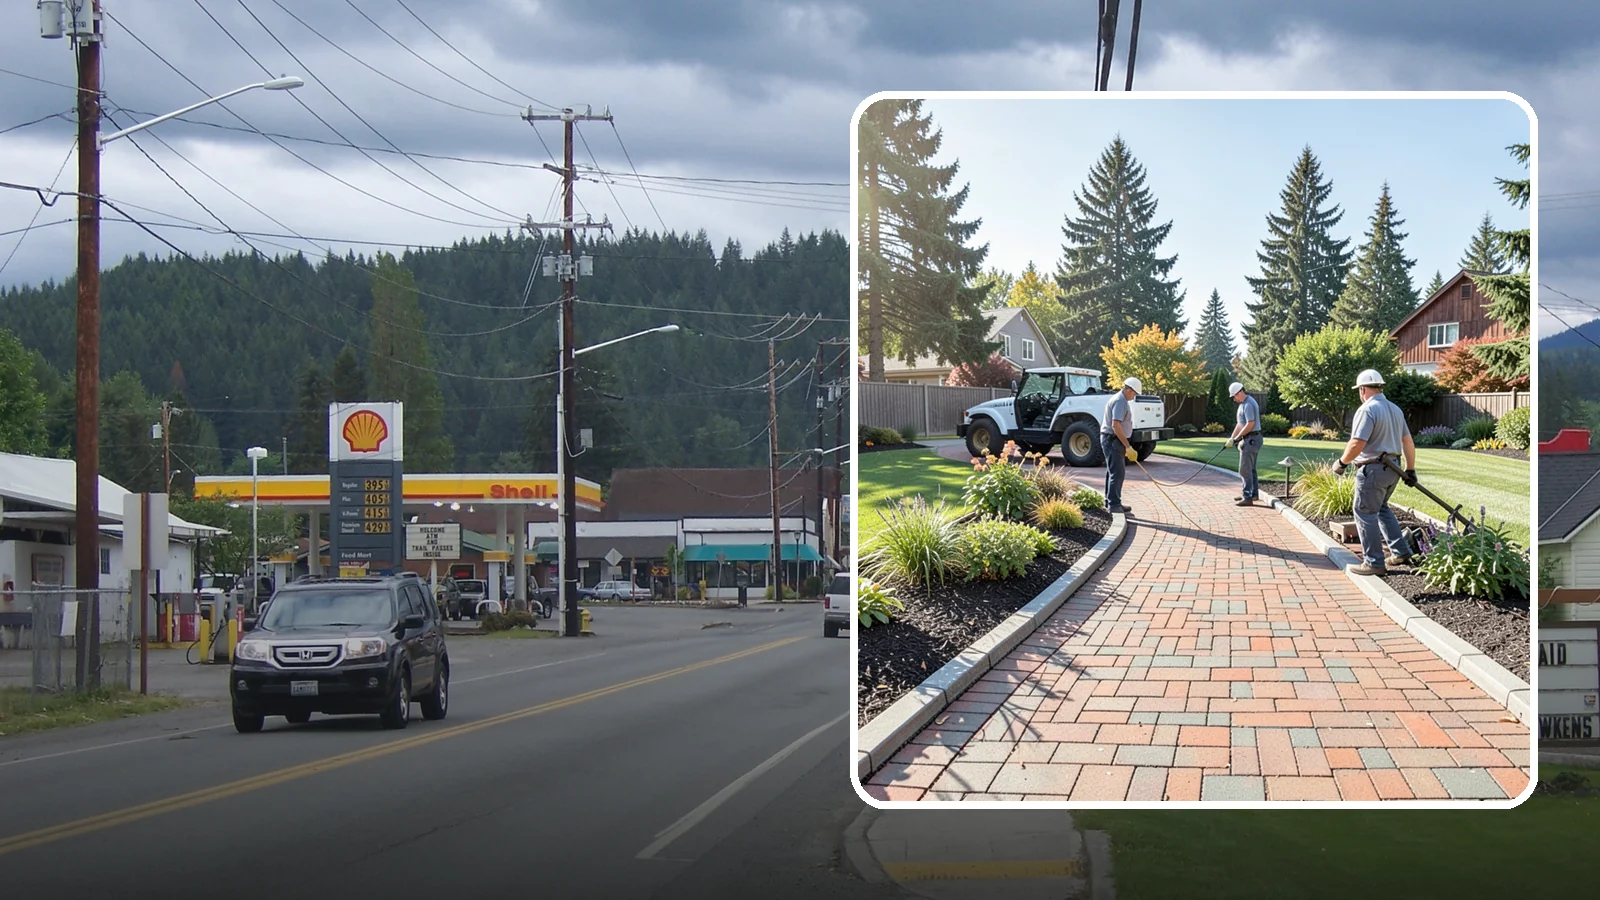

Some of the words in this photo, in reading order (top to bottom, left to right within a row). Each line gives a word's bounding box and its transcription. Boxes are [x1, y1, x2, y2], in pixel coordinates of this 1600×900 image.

[366, 480, 383, 490] 395
[490, 484, 547, 499] Shell
[366, 494, 383, 504] 405
[366, 508, 383, 518] 415
[366, 522, 383, 532] 429
